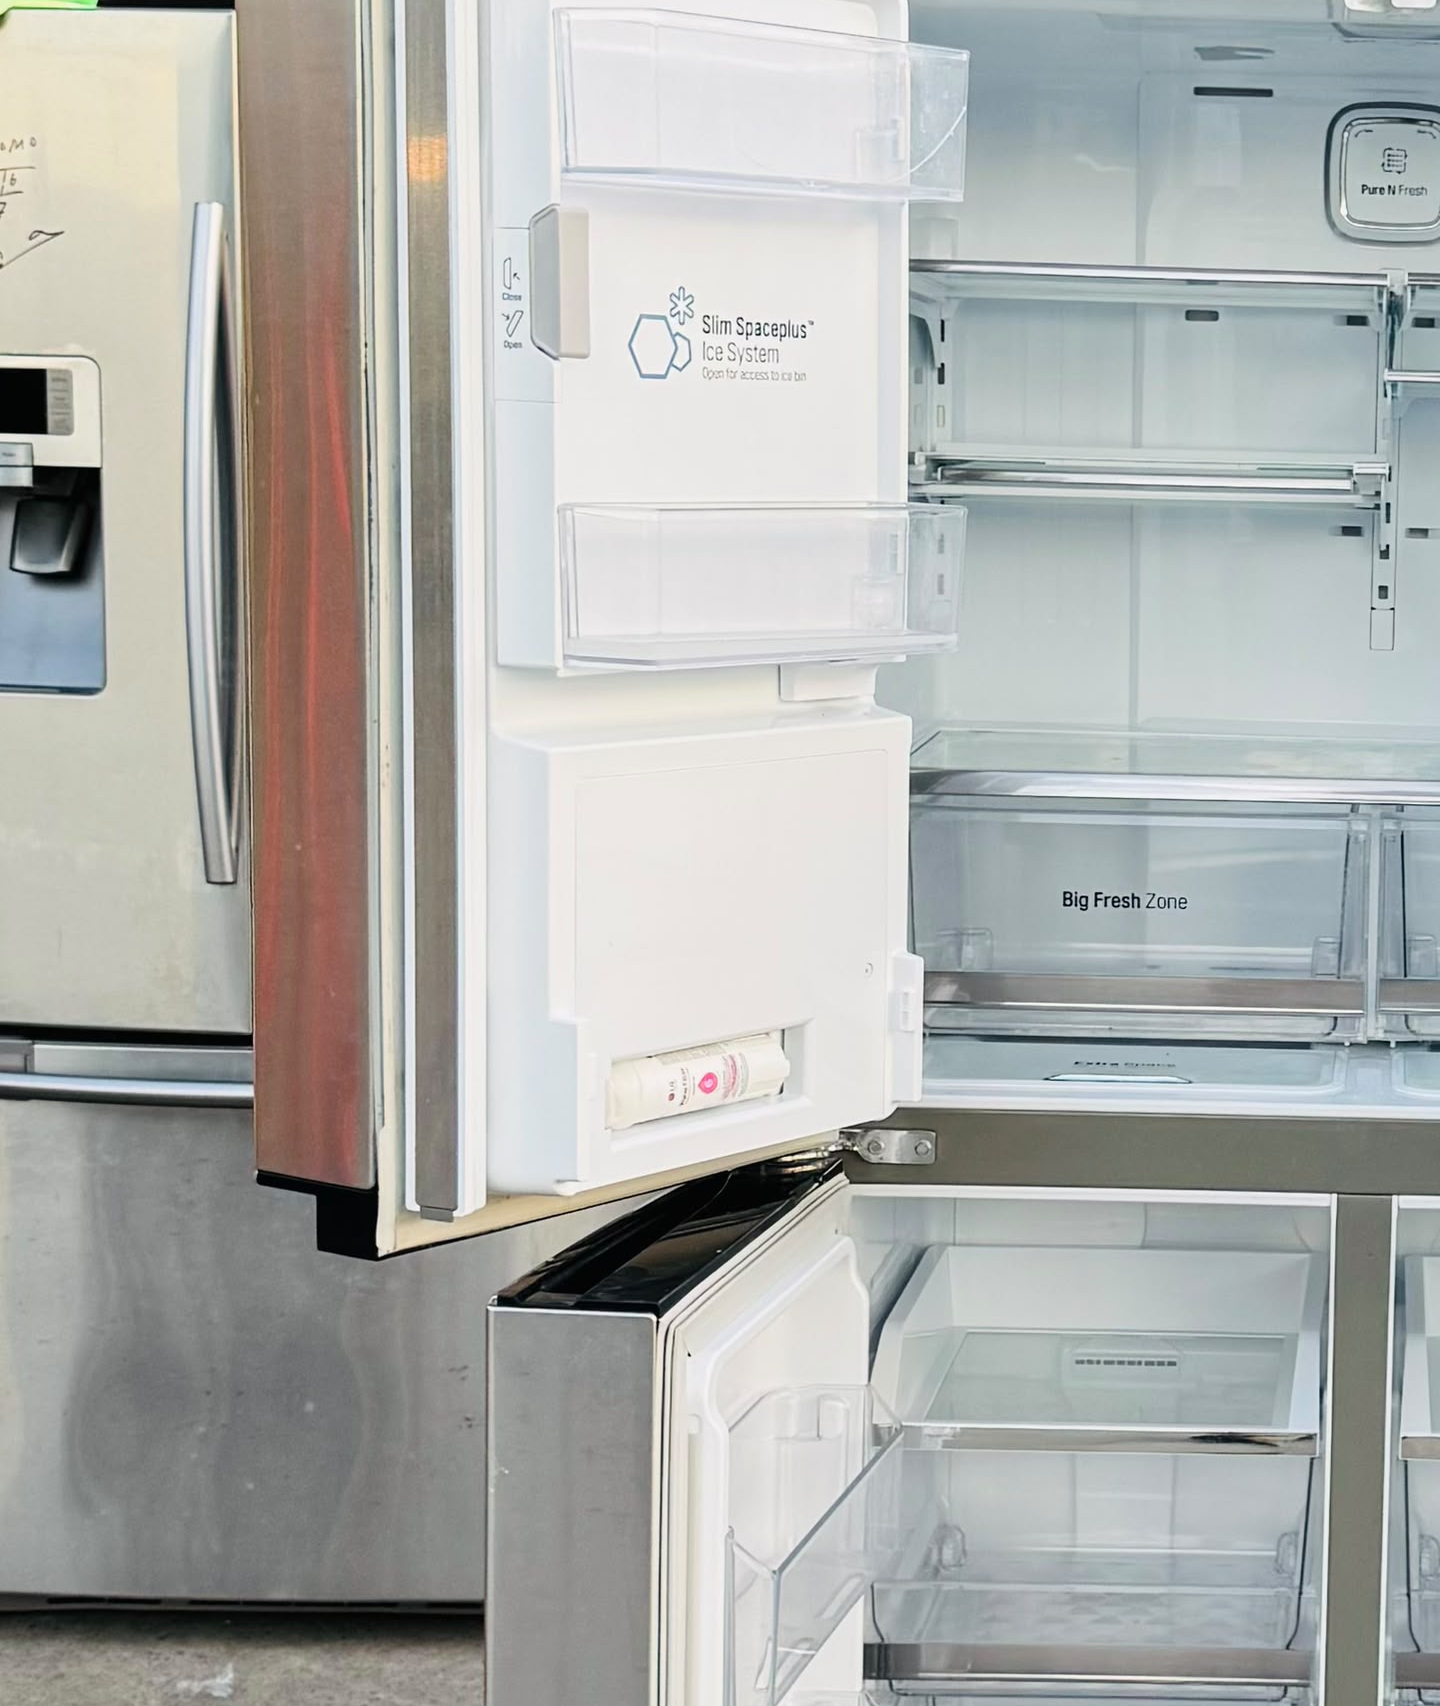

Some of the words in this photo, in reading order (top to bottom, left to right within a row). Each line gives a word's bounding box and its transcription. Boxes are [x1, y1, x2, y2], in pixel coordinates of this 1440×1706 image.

[1361, 184, 1386, 196] Pure
[1387, 185, 1396, 196] N
[1398, 185, 1428, 197] Fresh
[702, 314, 732, 335] Slim
[702, 341, 723, 361] Ice
[727, 342, 779, 366] System
[1062, 890, 1089, 911] Big
[1094, 891, 1141, 909] Fresh
[1145, 892, 1188, 910] Zone
